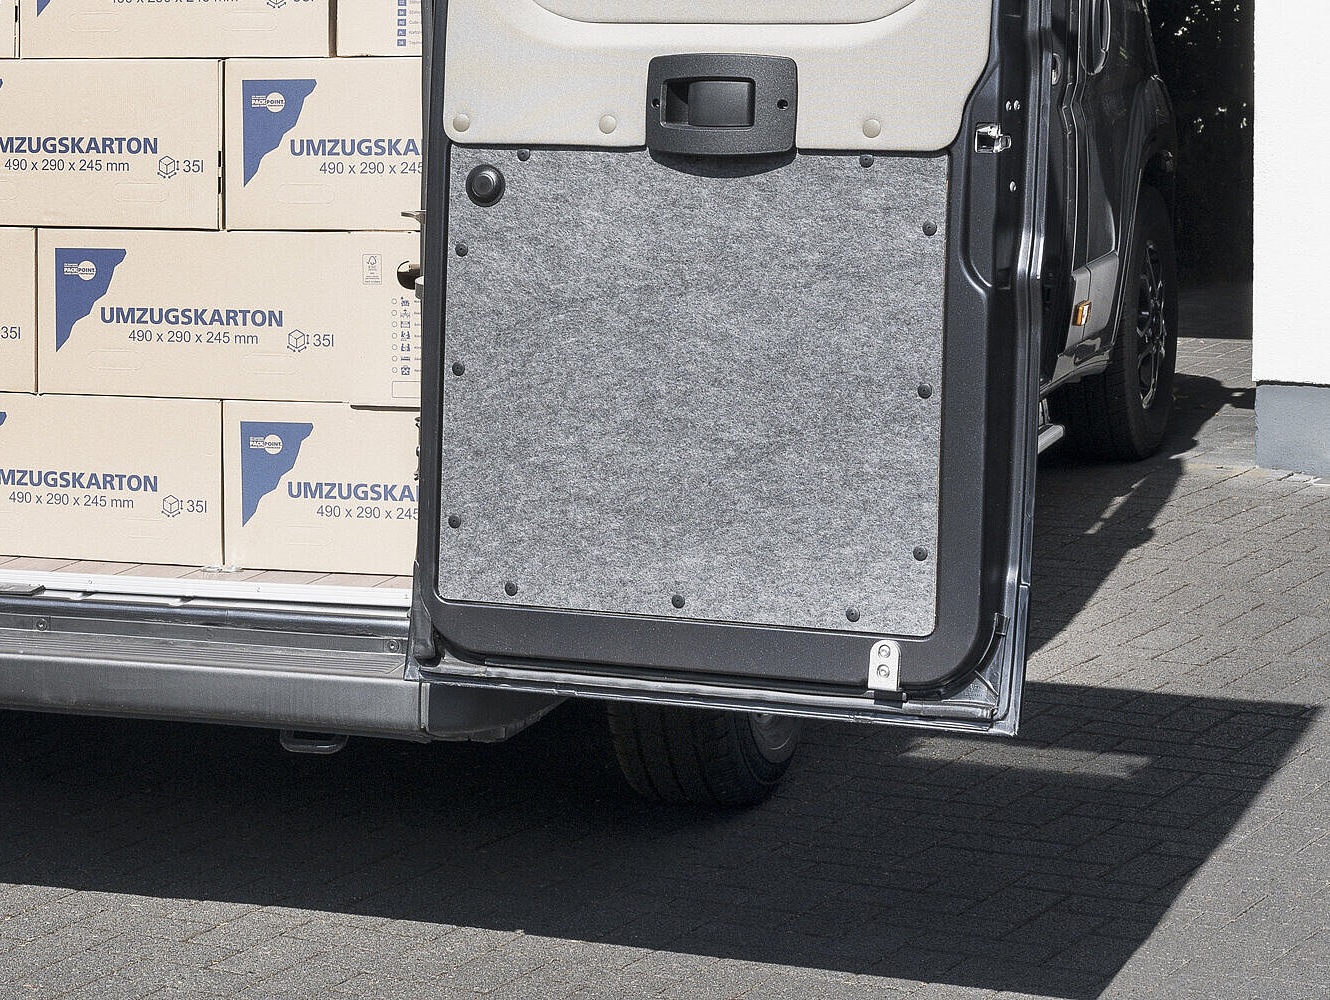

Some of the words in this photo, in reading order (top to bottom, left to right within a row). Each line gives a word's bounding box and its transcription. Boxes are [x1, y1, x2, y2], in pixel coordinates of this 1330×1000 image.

[290, 138, 422, 156] UMZUGSKA
[5, 159, 27, 170] 490
[31, 162, 38, 170] x
[42, 159, 64, 171] 290
[69, 162, 75, 171] x
[79, 159, 102, 171] 245
[107, 163, 129, 171] mm
[320, 162, 344, 174] 490
[349, 165, 355, 174] x
[360, 162, 384, 174] 290
[389, 165, 396, 174] x
[101, 307, 283, 327] UMZUGSKARTON
[129, 330, 152, 341] 490
[157, 333, 163, 342] x
[168, 331, 191, 342] 290
[195, 334, 202, 343] x
[206, 332, 230, 343] 245
[235, 335, 258, 344] mm
[9, 491, 31, 503] 490
[36, 495, 42, 504] x
[47, 493, 69, 505] 290
[73, 497, 80, 506] x
[84, 495, 106, 507] 245
[111, 499, 133, 508] mm
[288, 483, 419, 502] UMZUGSKA
[317, 505, 340, 517] 490
[345, 509, 352, 518] x
[357, 506, 380, 518] 290
[385, 510, 392, 519] x
